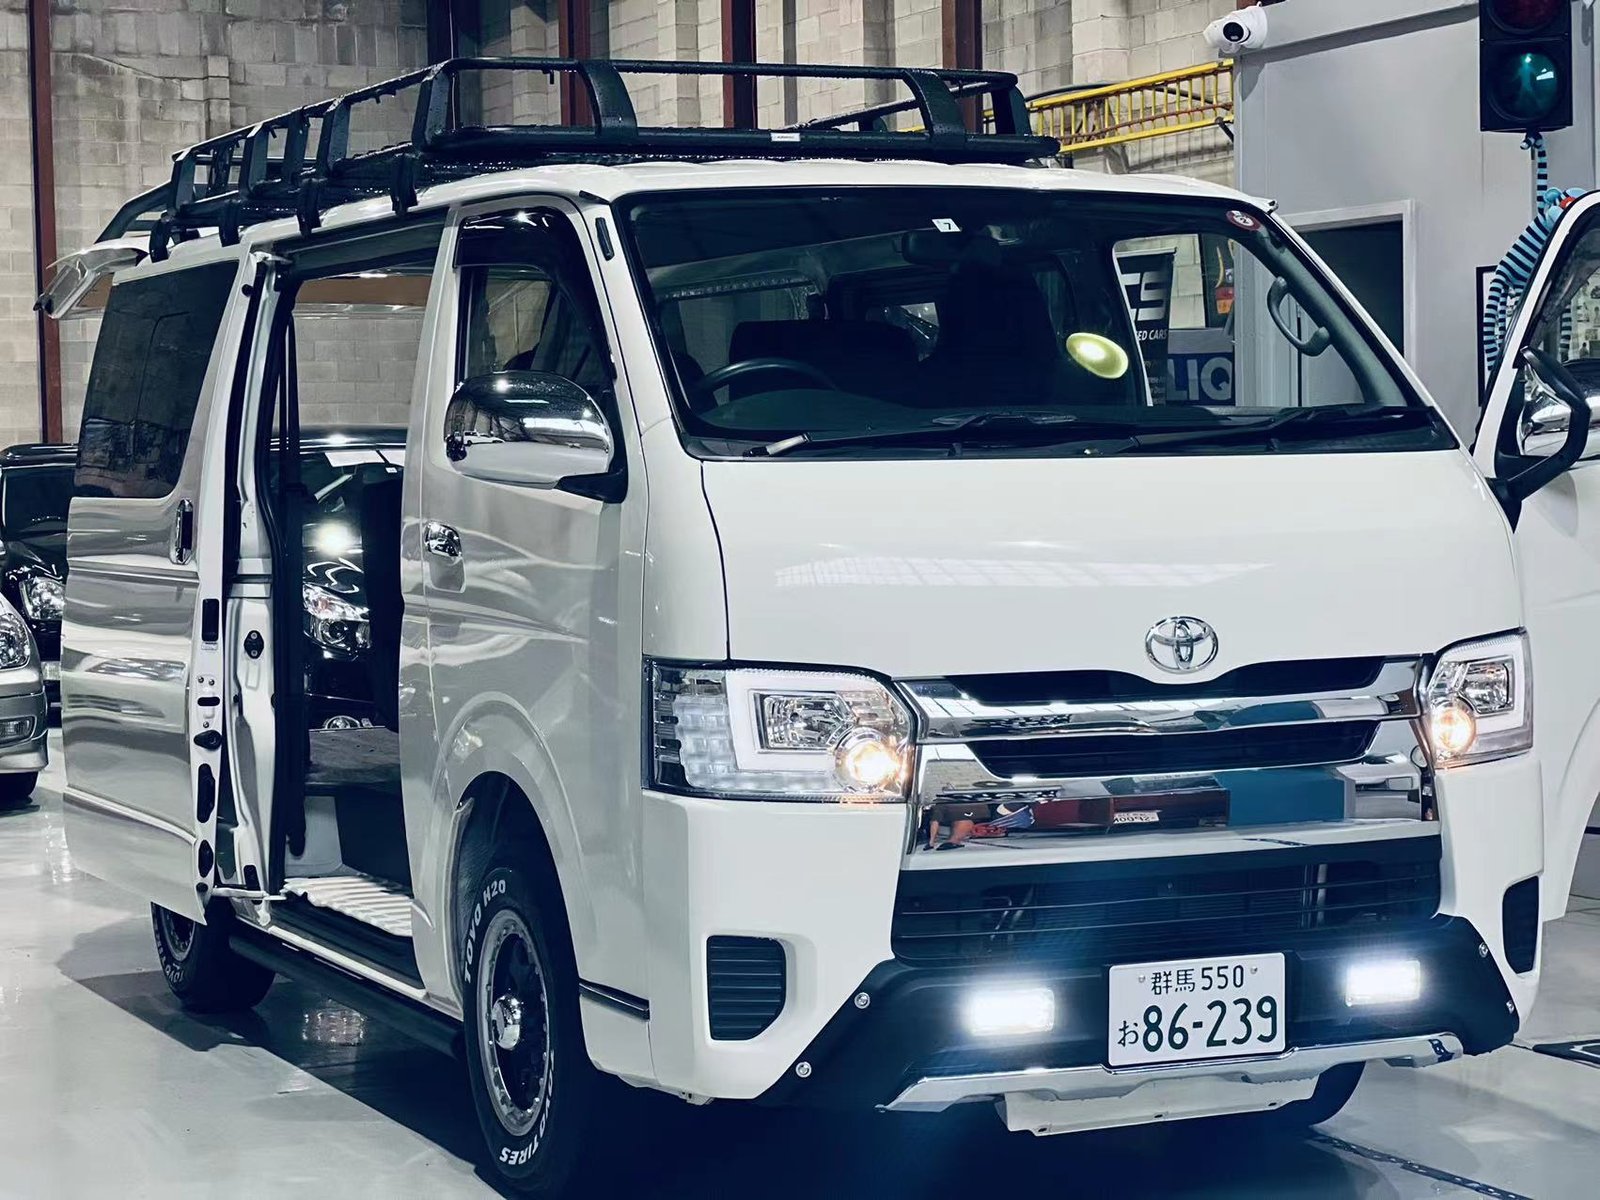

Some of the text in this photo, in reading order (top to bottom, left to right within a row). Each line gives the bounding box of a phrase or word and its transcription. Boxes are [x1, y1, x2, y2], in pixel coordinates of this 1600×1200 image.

[1148, 329, 1168, 340] CARS
[464, 902, 482, 984] TOYO
[1201, 964, 1245, 991] 550
[1142, 995, 1278, 1053] 86-239
[498, 1134, 539, 1165] TIRES
